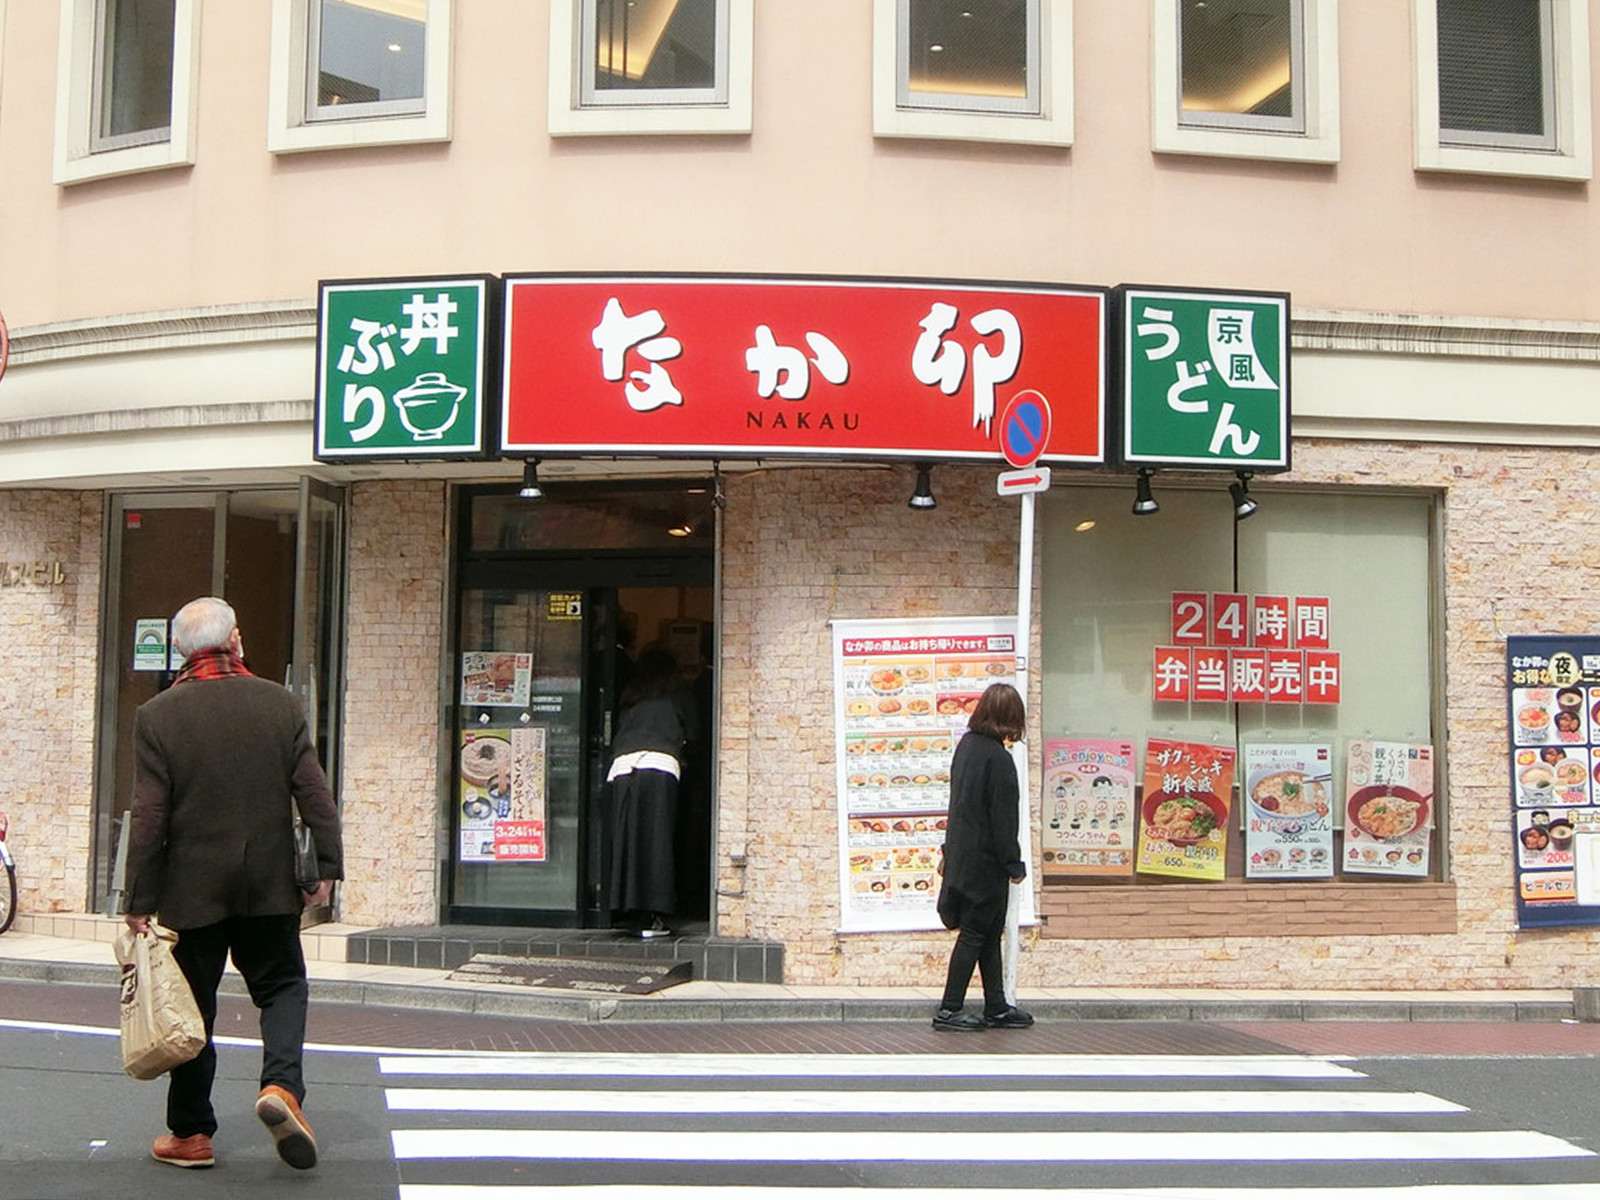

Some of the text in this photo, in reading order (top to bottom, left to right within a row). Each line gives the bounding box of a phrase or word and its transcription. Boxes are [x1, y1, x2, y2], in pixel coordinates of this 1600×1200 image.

[592, 297, 1021, 437] なか卯
[1216, 316, 1255, 382] 京風
[1137, 306, 1260, 455] うどん
[747, 411, 859, 430] NAKAU
[1176, 601, 1328, 640] 24時間
[1156, 656, 1338, 696] 弁当販売中
[1555, 655, 1571, 675] 夜
[1162, 773, 1215, 794] 新食感
